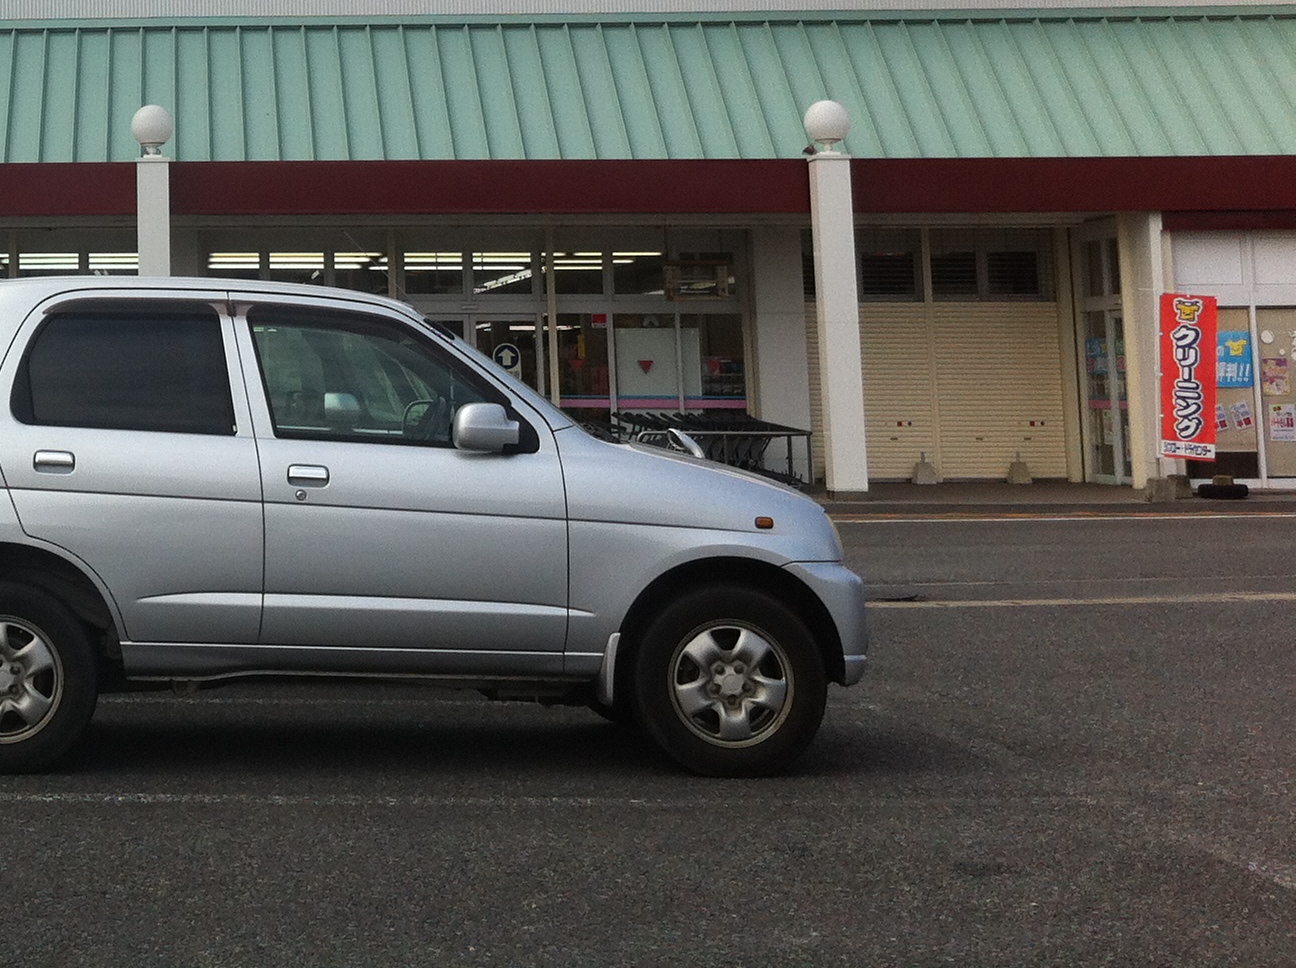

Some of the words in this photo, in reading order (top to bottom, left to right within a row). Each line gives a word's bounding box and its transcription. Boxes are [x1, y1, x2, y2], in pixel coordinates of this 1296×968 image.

[1172, 325, 1203, 439] クリーニング
